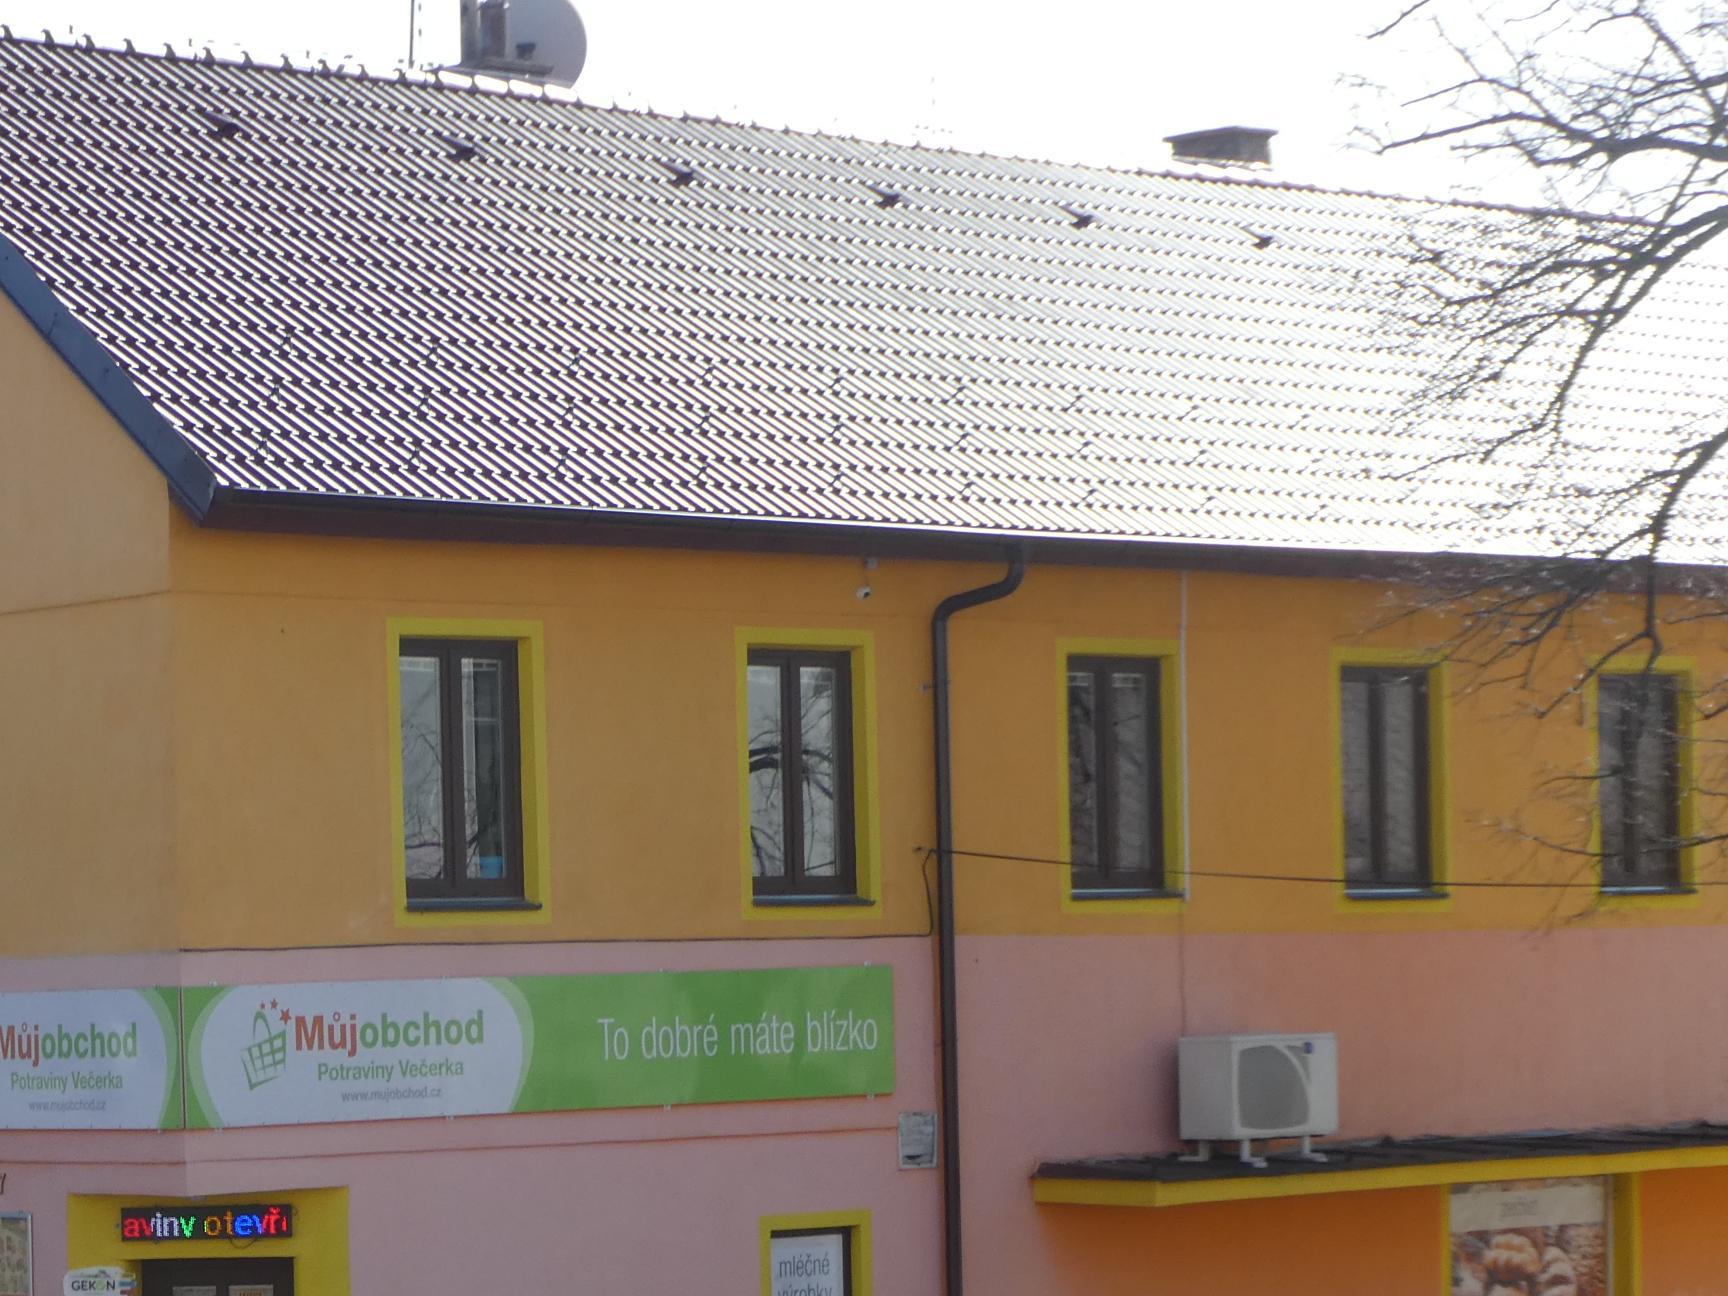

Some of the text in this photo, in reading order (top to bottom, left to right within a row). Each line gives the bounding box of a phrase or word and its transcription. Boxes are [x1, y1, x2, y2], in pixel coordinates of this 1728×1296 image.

[294, 1009, 484, 1058] Můjobchod
[597, 1009, 878, 1060] To dobré máte blízko
[10, 1070, 123, 1094] Potraviny Večerka
[317, 1057, 464, 1083] Potraviny Večerka
[778, 1252, 831, 1279] mléčné
